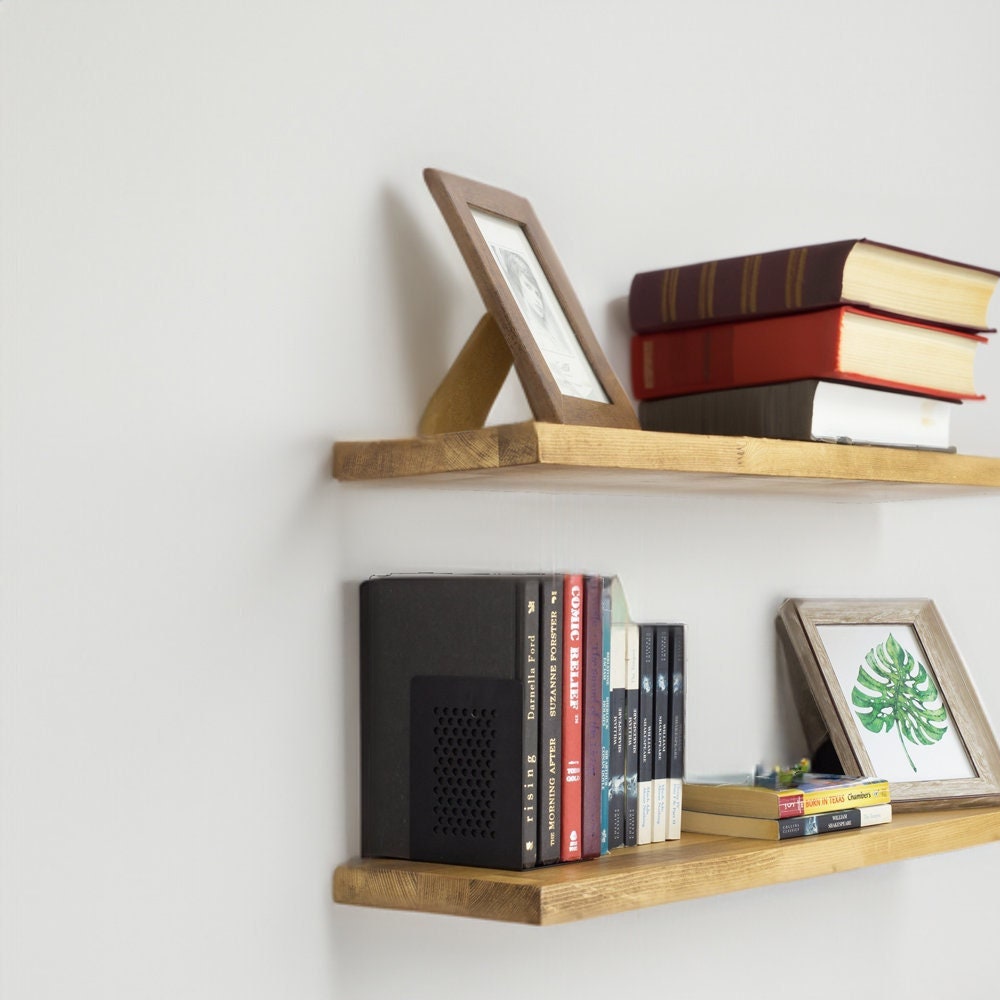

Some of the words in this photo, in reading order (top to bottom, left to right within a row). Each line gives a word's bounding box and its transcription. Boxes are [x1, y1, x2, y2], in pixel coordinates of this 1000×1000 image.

[550, 610, 558, 662] FORSTER
[570, 585, 581, 641] COMIC
[527, 635, 536, 663] Ford
[527, 667, 536, 720] Darnella
[549, 665, 557, 717] SUZANNE
[569, 646, 580, 710] RELIEF
[523, 754, 537, 823] rising
[548, 777, 556, 831] MORNING
[822, 797, 829, 806] IN
[830, 796, 845, 805] TEXAS
[847, 791, 872, 801] Chambers
[828, 820, 852, 829] SHAKESPEARE
